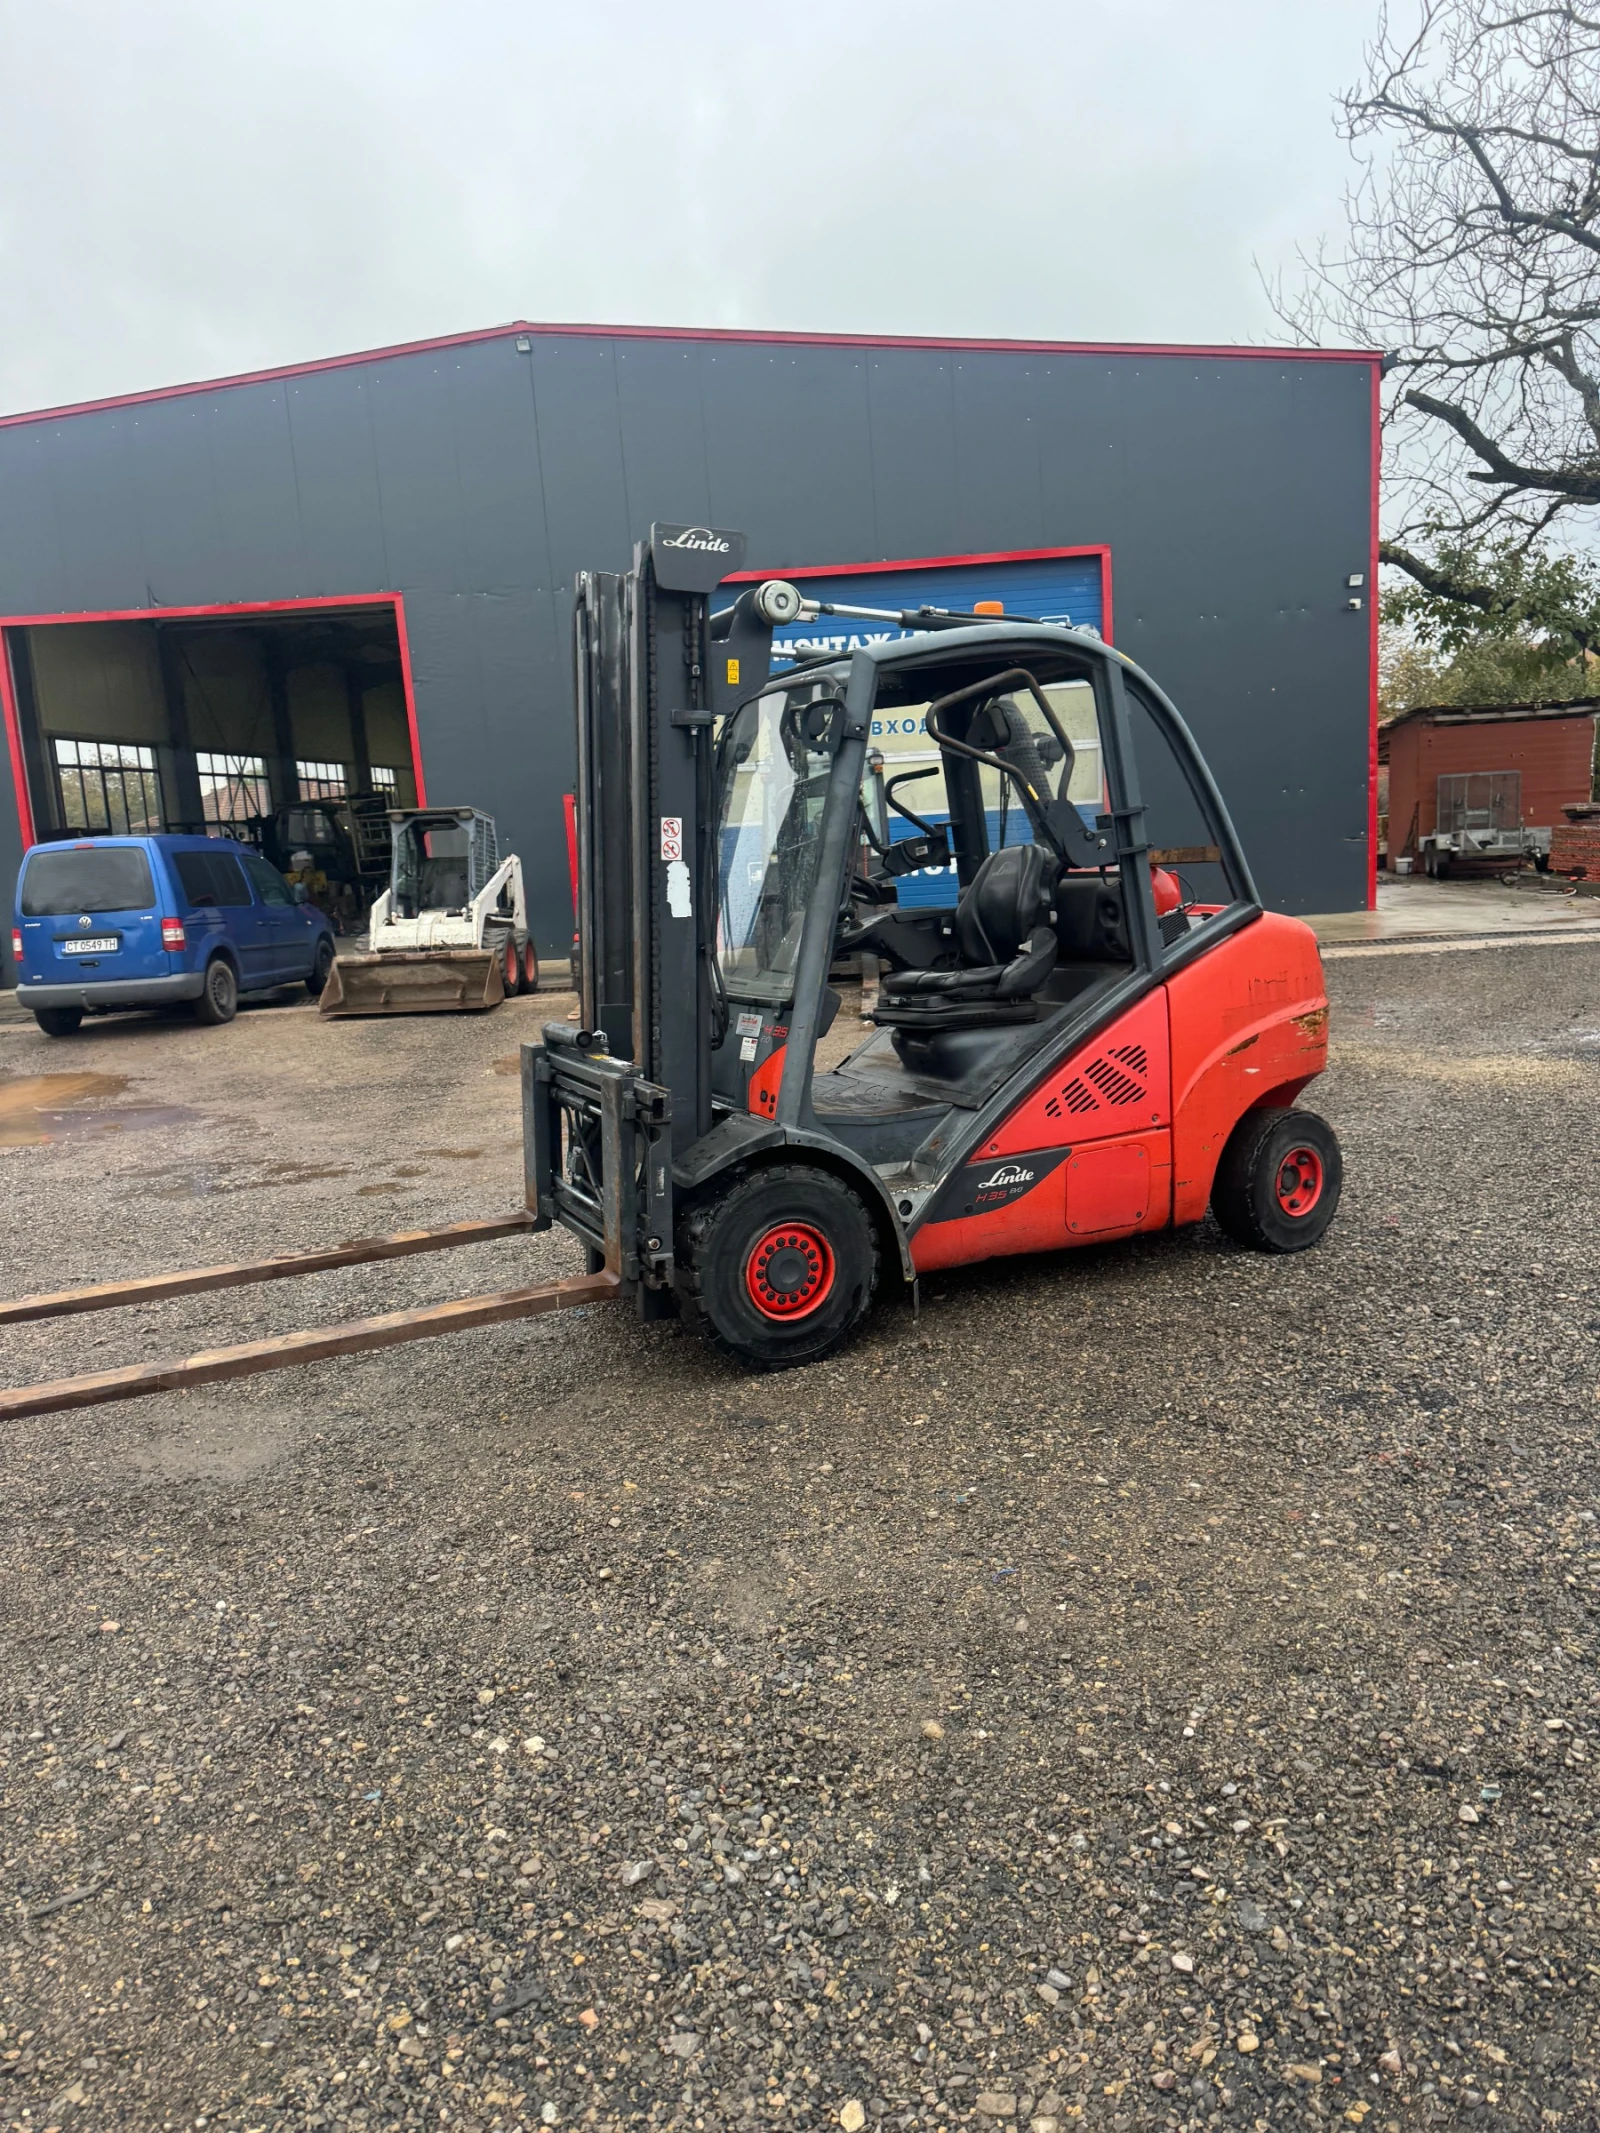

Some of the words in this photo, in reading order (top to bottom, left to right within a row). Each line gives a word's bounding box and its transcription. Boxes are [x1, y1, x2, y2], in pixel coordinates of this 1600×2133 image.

[663, 528, 729, 552] Linde
[67, 941, 79, 951] CT
[81, 940, 102, 950] 0549
[103, 939, 116, 949] TH
[978, 1165, 1034, 1188] Linde
